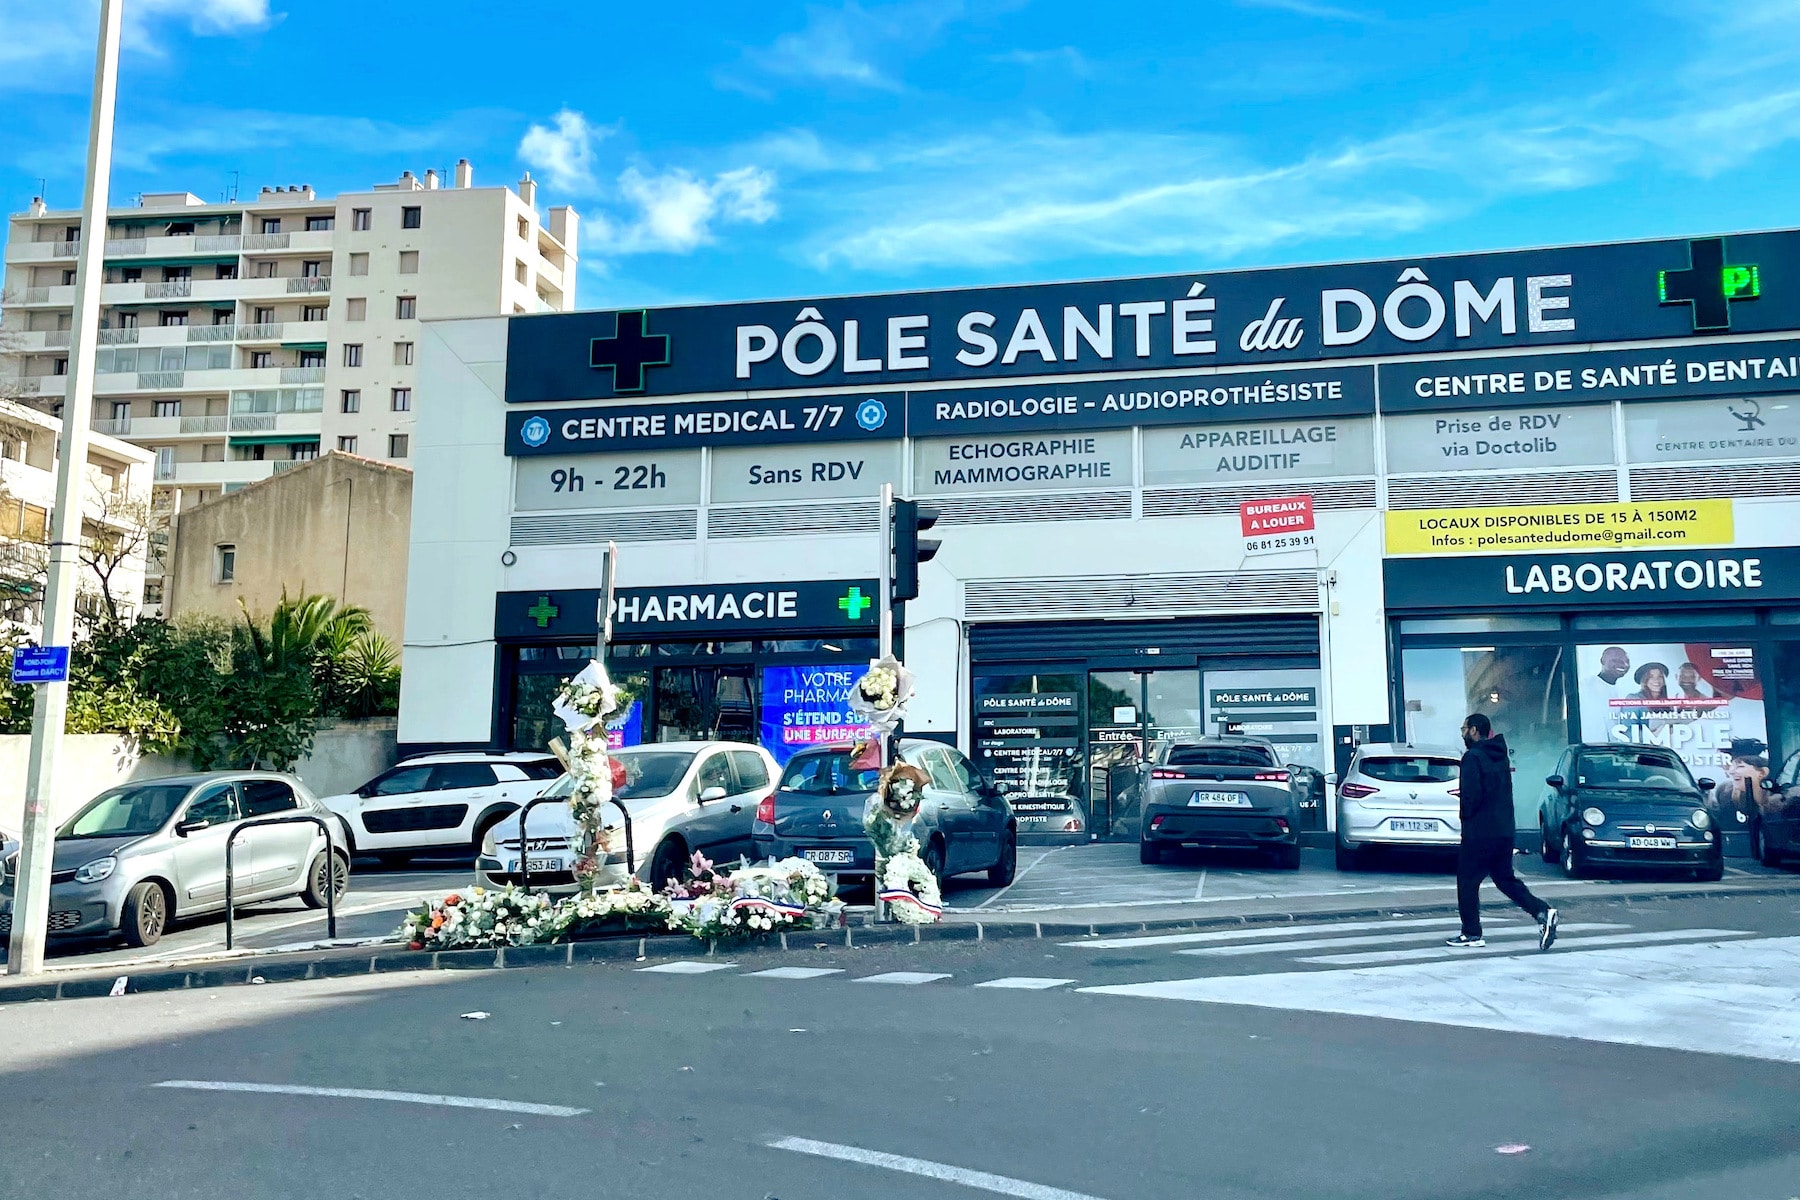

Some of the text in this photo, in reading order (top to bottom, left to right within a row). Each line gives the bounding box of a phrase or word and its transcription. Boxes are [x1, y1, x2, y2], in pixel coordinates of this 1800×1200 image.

[736, 267, 1576, 379] PÔLE SANTÉ du DÔME
[1414, 356, 1800, 397] CENTRE DE SANTÉ DENTAI
[935, 396, 1078, 420] RADIOLOGIE
[1101, 379, 1343, 412] AUDIOPROTHÉSISTE
[561, 404, 844, 440] CENTRE MEDICAL 7/7
[1435, 413, 1562, 434] Prise de RDV
[1179, 426, 1337, 449] APPAREILLAGE
[1440, 437, 1558, 457] via Doctolib
[1655, 441, 1705, 451] CENTRE
[1708, 438, 1774, 449] DENTAIRE
[949, 438, 1096, 460] ECHOGRAPHIE
[1215, 453, 1301, 472] AUDITIF
[550, 467, 584, 493] 9h
[613, 463, 666, 490] 22h
[748, 460, 865, 485] Sans RDV
[934, 462, 1112, 485] MAMMOGRAPHIE
[1246, 501, 1306, 515] BUREAUX
[1251, 515, 1305, 530] A LOUER
[1419, 509, 1698, 530] LOCAUX DISPONIBLES DE 15 À 150M2
[1247, 536, 1315, 551] 06 81 25 39 91
[1431, 534, 1465, 546] Infos
[1477, 528, 1686, 548] polesantedudome@gmail.com
[1504, 558, 1763, 594] LABORATOIRE
[802, 671, 853, 687] VOTRE
[784, 688, 851, 704] PHARMA
[983, 697, 1007, 707] PÔLE
[1007, 697, 1037, 707] SANTÉ
[1046, 697, 1072, 706] DÔME
[1216, 693, 1240, 703] PÔLE
[1242, 692, 1273, 702] SANTÉ
[1282, 692, 1310, 701] DÔME
[783, 708, 842, 725] S'ÉTEND
[1609, 709, 1730, 720] IL N'A JAMAIS ÉTÉ AUSSI
[784, 728, 873, 742] UNE SURFACE
[1098, 731, 1134, 741] Entrée
[1610, 723, 1733, 749] SIMPLE
[1682, 752, 1733, 766] PISTER
[818, 851, 836, 861] 087
